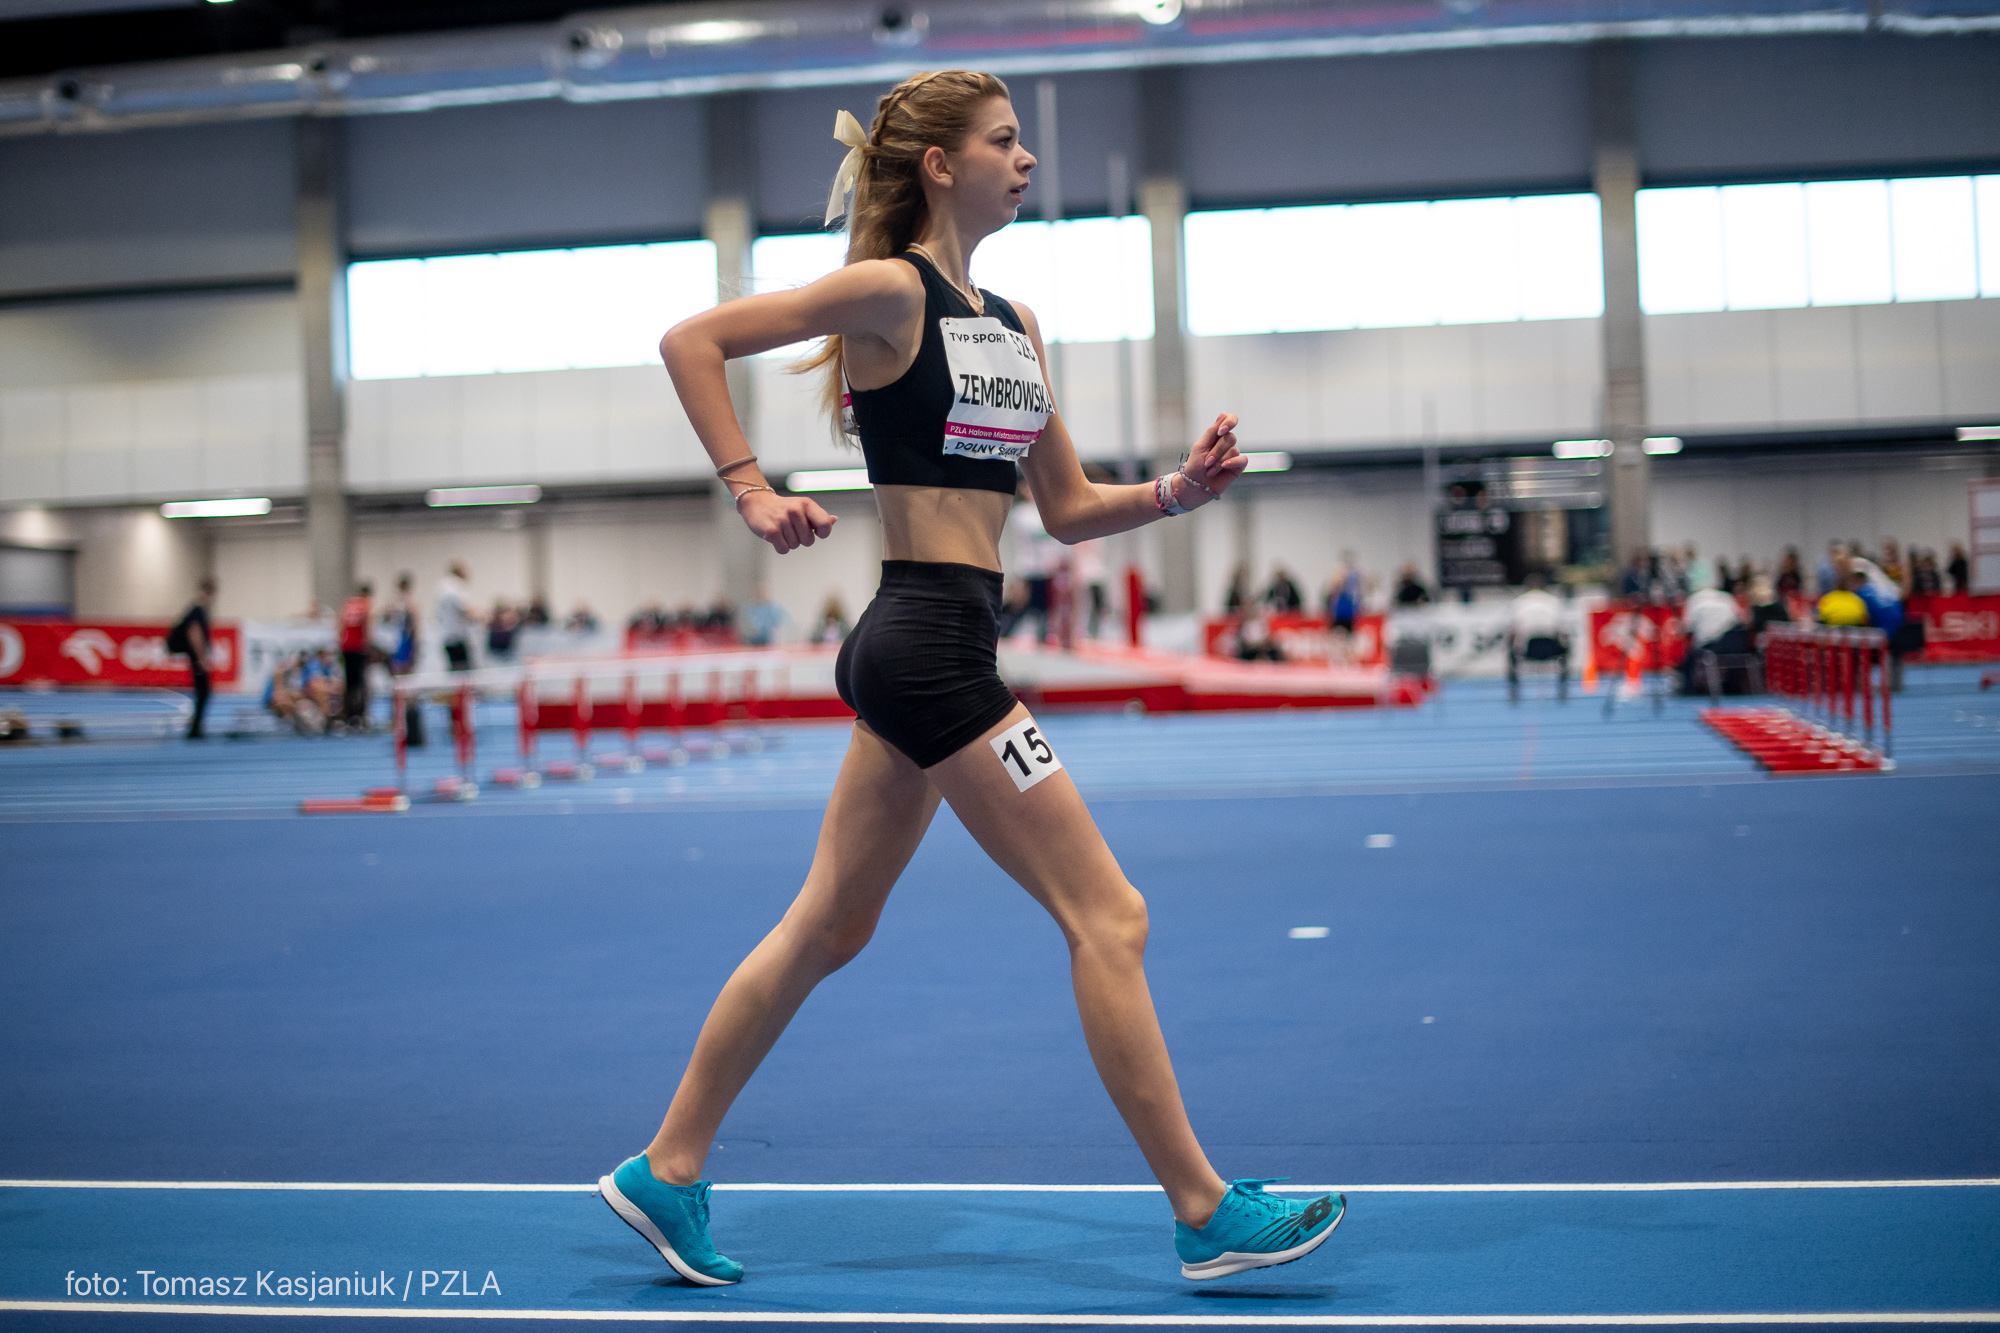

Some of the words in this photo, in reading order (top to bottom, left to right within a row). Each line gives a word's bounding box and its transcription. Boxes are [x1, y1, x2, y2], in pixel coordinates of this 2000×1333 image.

[949, 332, 970, 342] TVP
[973, 332, 1006, 344] SPORT
[950, 425, 967, 435] PZLA
[968, 428, 993, 438] Halowe
[955, 441, 995, 455] DOLNY
[1001, 726, 1053, 777] 15
